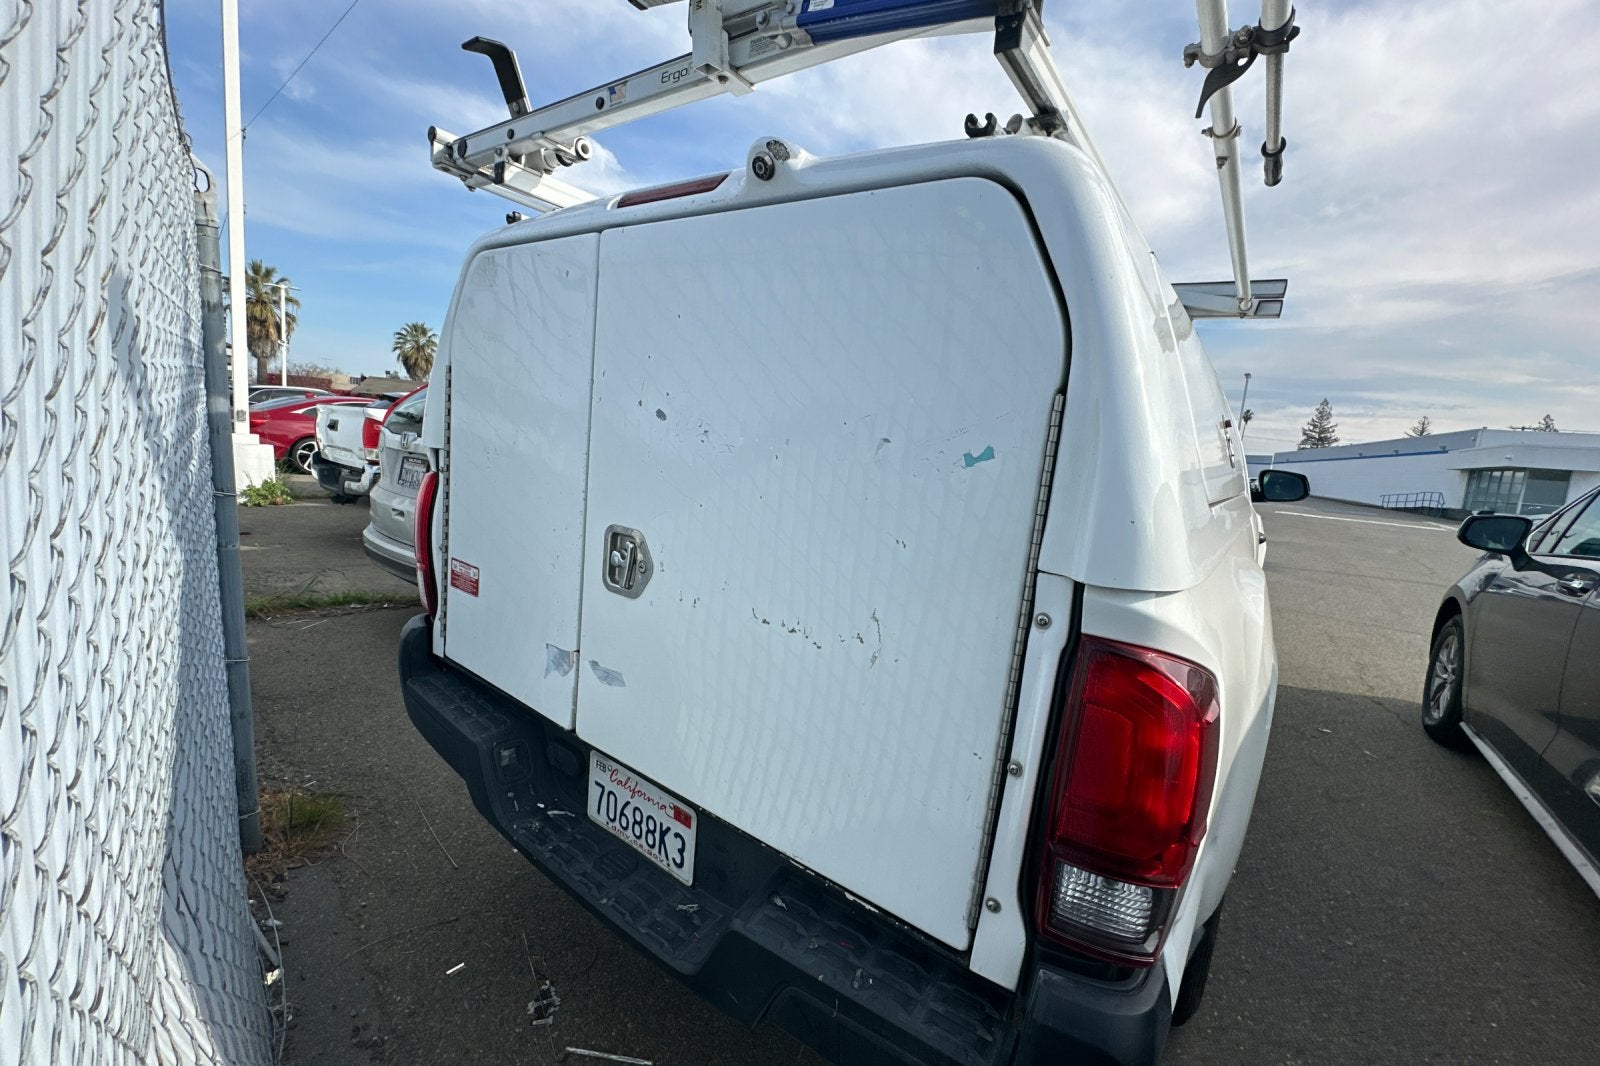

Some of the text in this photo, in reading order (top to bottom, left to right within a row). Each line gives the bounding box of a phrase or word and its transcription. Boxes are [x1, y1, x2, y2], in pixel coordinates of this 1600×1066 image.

[595, 760, 607, 773] FEB
[609, 769, 672, 817] California
[594, 779, 686, 869] 70688K3
[611, 825, 664, 863] dmv.ca.gov
